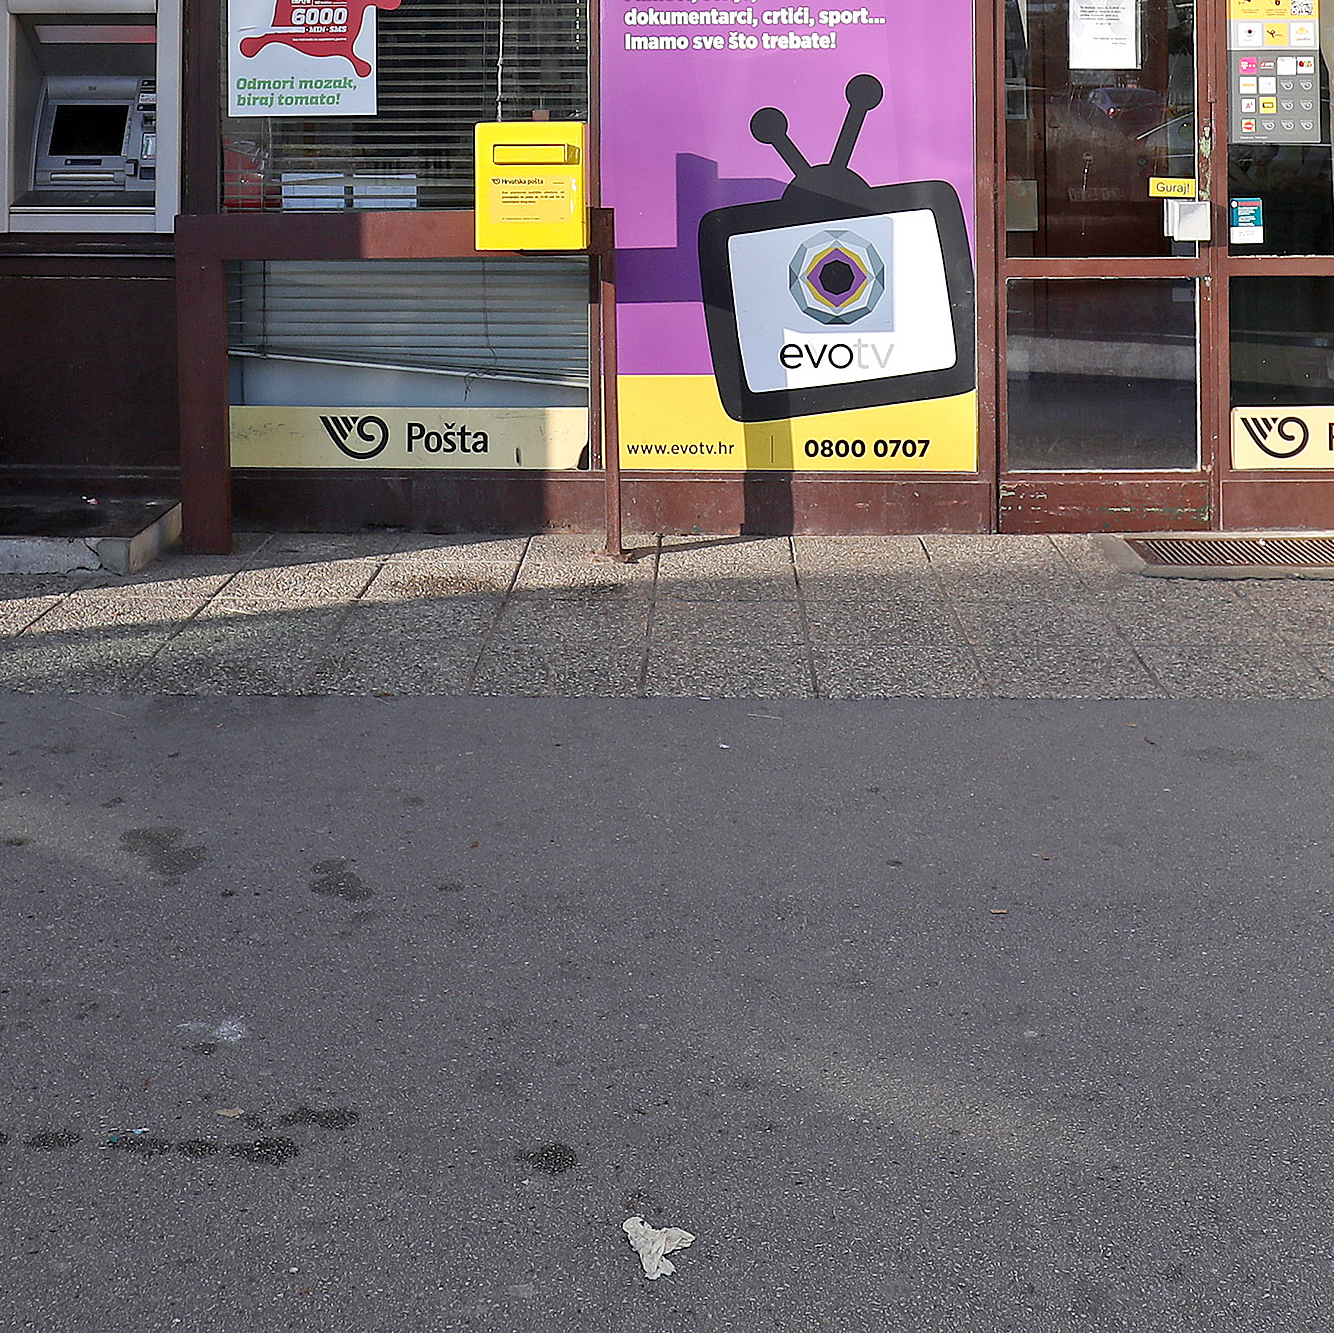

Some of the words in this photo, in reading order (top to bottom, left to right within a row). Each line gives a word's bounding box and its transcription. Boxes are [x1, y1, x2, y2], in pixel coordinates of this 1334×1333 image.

[291, 7, 348, 25] 6000
[624, 7, 759, 28] dokumentarci,
[762, 6, 816, 27] crtići,
[818, 7, 887, 28] sport...
[624, 32, 689, 51] Imamo
[692, 35, 726, 51] sve
[728, 31, 759, 51] što
[761, 31, 838, 51] trebate!
[236, 76, 295, 91] Odmori
[298, 76, 358, 92] mozak,
[236, 93, 275, 108] biraj
[278, 93, 341, 106] tomato!
[527, 177, 544, 185] pošta
[1156, 181, 1190, 195] Guraj!
[779, 338, 895, 369] evotv
[407, 422, 490, 453] Pošta
[626, 441, 735, 455] www.evotv.hr
[803, 439, 866, 458] 0800
[872, 439, 930, 458] 0707
